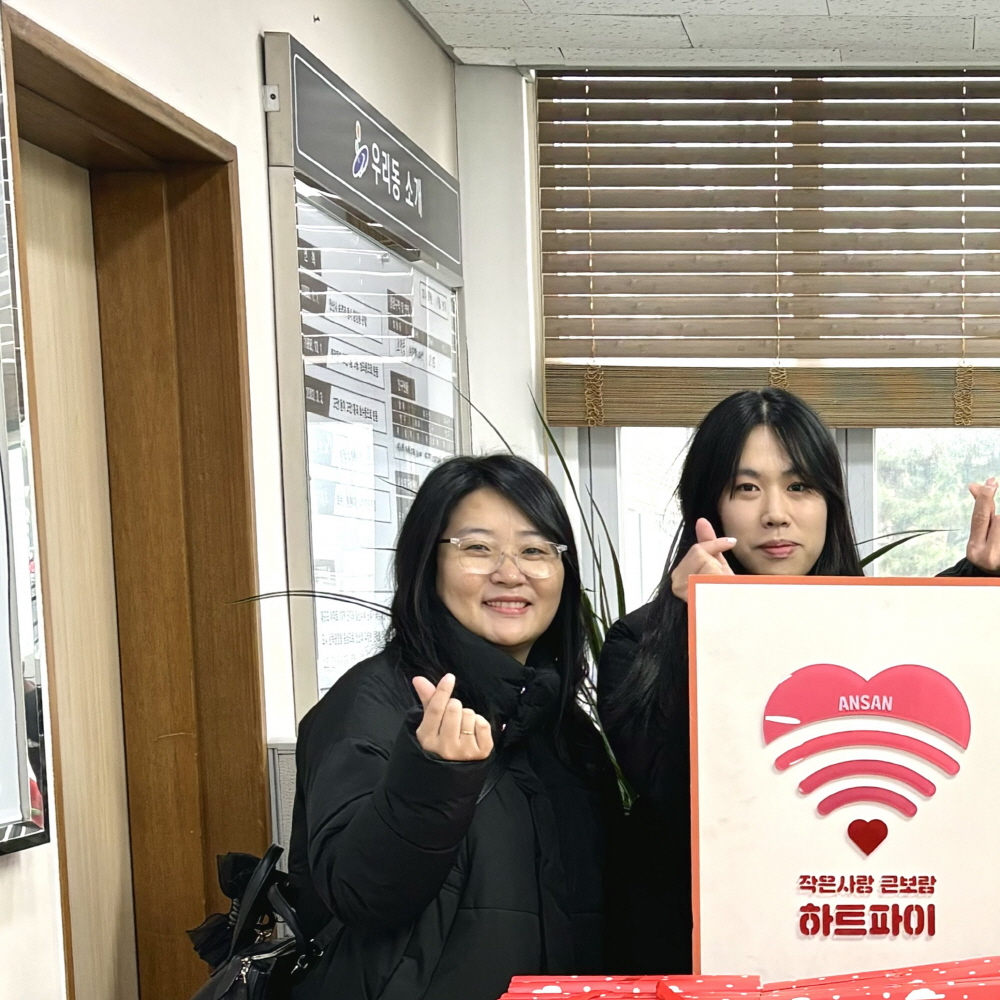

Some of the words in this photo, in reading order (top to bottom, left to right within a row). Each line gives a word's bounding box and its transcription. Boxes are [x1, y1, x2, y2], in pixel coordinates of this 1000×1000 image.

[372, 143, 400, 201] 우리동
[405, 171, 422, 218] 소개
[838, 695, 893, 711] ANSAN
[799, 875, 875, 894] 작은사랑
[880, 875, 937, 894] 큰보람
[799, 903, 935, 937] 하트파이
